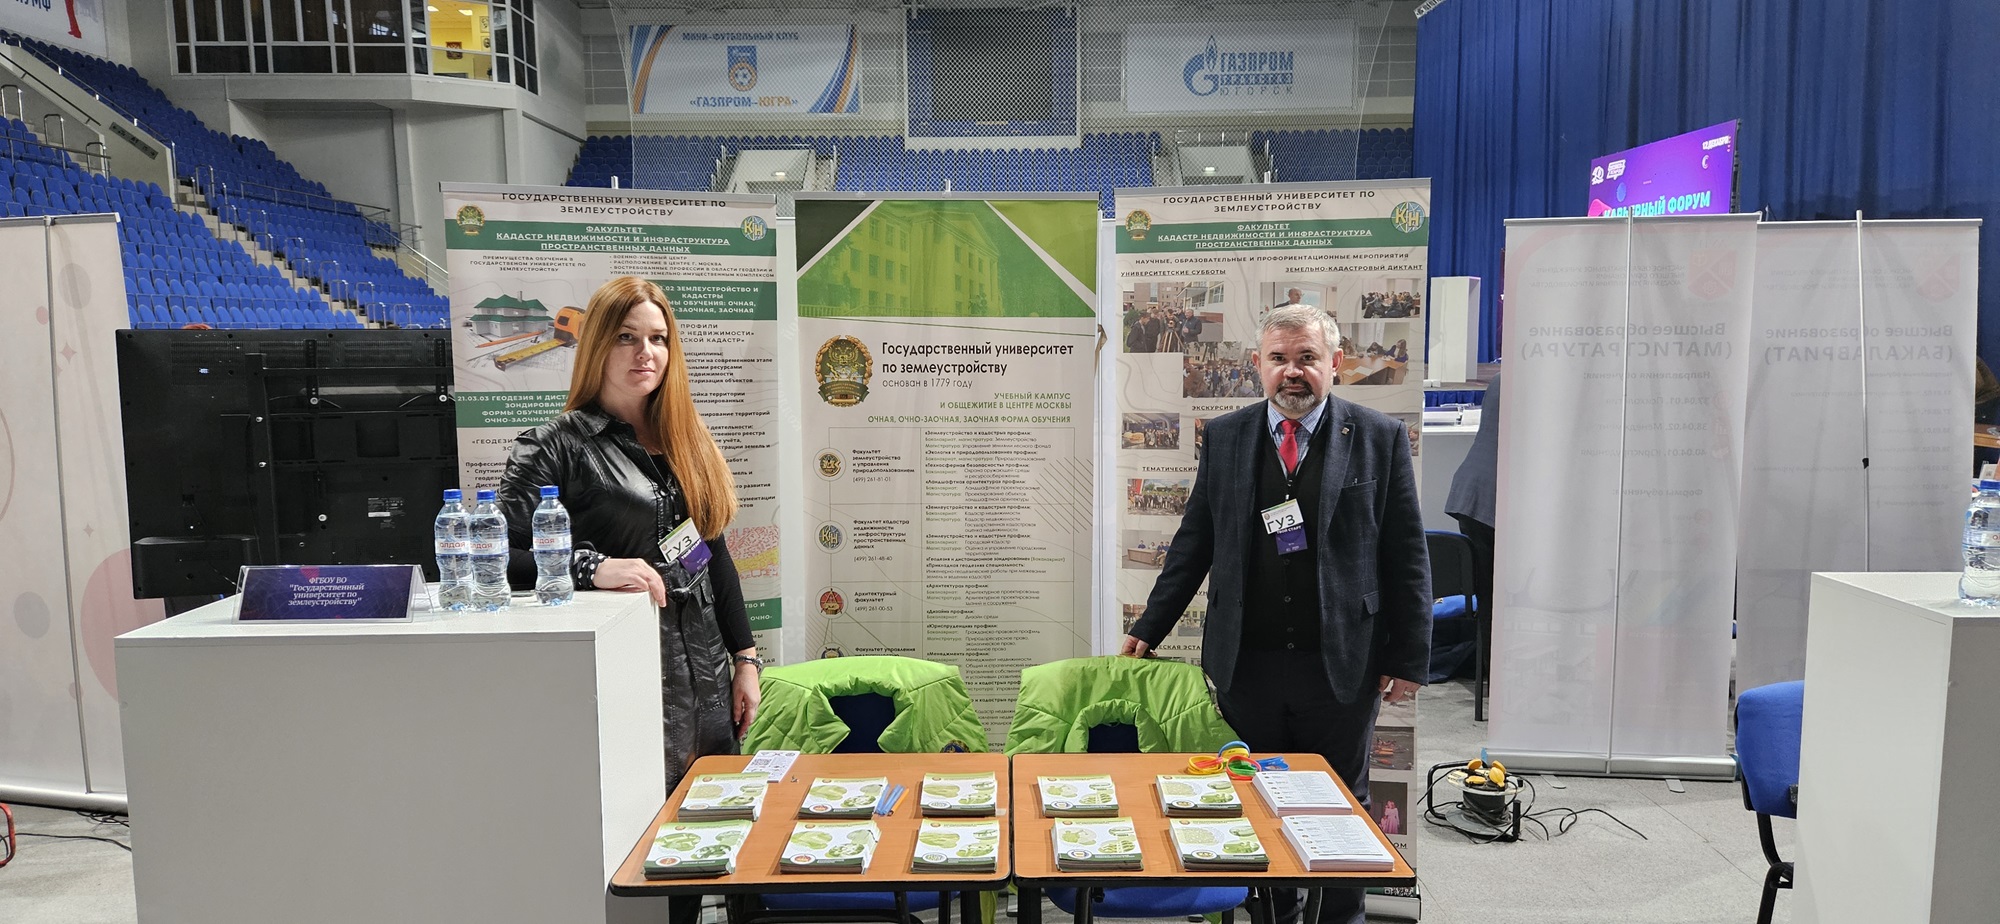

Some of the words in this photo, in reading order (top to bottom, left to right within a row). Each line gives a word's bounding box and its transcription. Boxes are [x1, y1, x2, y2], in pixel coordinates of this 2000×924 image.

[1221, 52, 1293, 72] ГАЗПРОМ
[627, 197, 707, 207] УНИВЕРСИТЕТ
[1164, 192, 1272, 204] ГОСУДАРСТВЕННЫЙ
[1277, 192, 1355, 200] УНИВЕРСИТЕТ
[1668, 191, 1711, 213] ФОРУМ
[560, 206, 673, 216] ЗЕМЛЕУСТРОЙСТВУ
[1214, 203, 1321, 212] ЗЕМЛЕУСТРОЙСТВУ
[643, 236, 730, 245] ИНФРАСТРУКТУРА
[1201, 232, 1276, 240] НЕДВИЖИМОСТИ
[1195, 240, 1290, 248] ПРОСТРАНСТВЕННЫХ
[882, 342, 991, 357] Государственный
[996, 345, 1073, 357] университет
[882, 363, 897, 373] по
[900, 361, 1008, 376] землеустройству
[931, 378, 950, 387] 1779
[953, 380, 973, 389] году
[1267, 515, 1295, 532] ГУЗ
[666, 536, 692, 561] ГУЗ
[290, 583, 365, 593] "Государственный
[288, 598, 362, 607] землеустройству"
